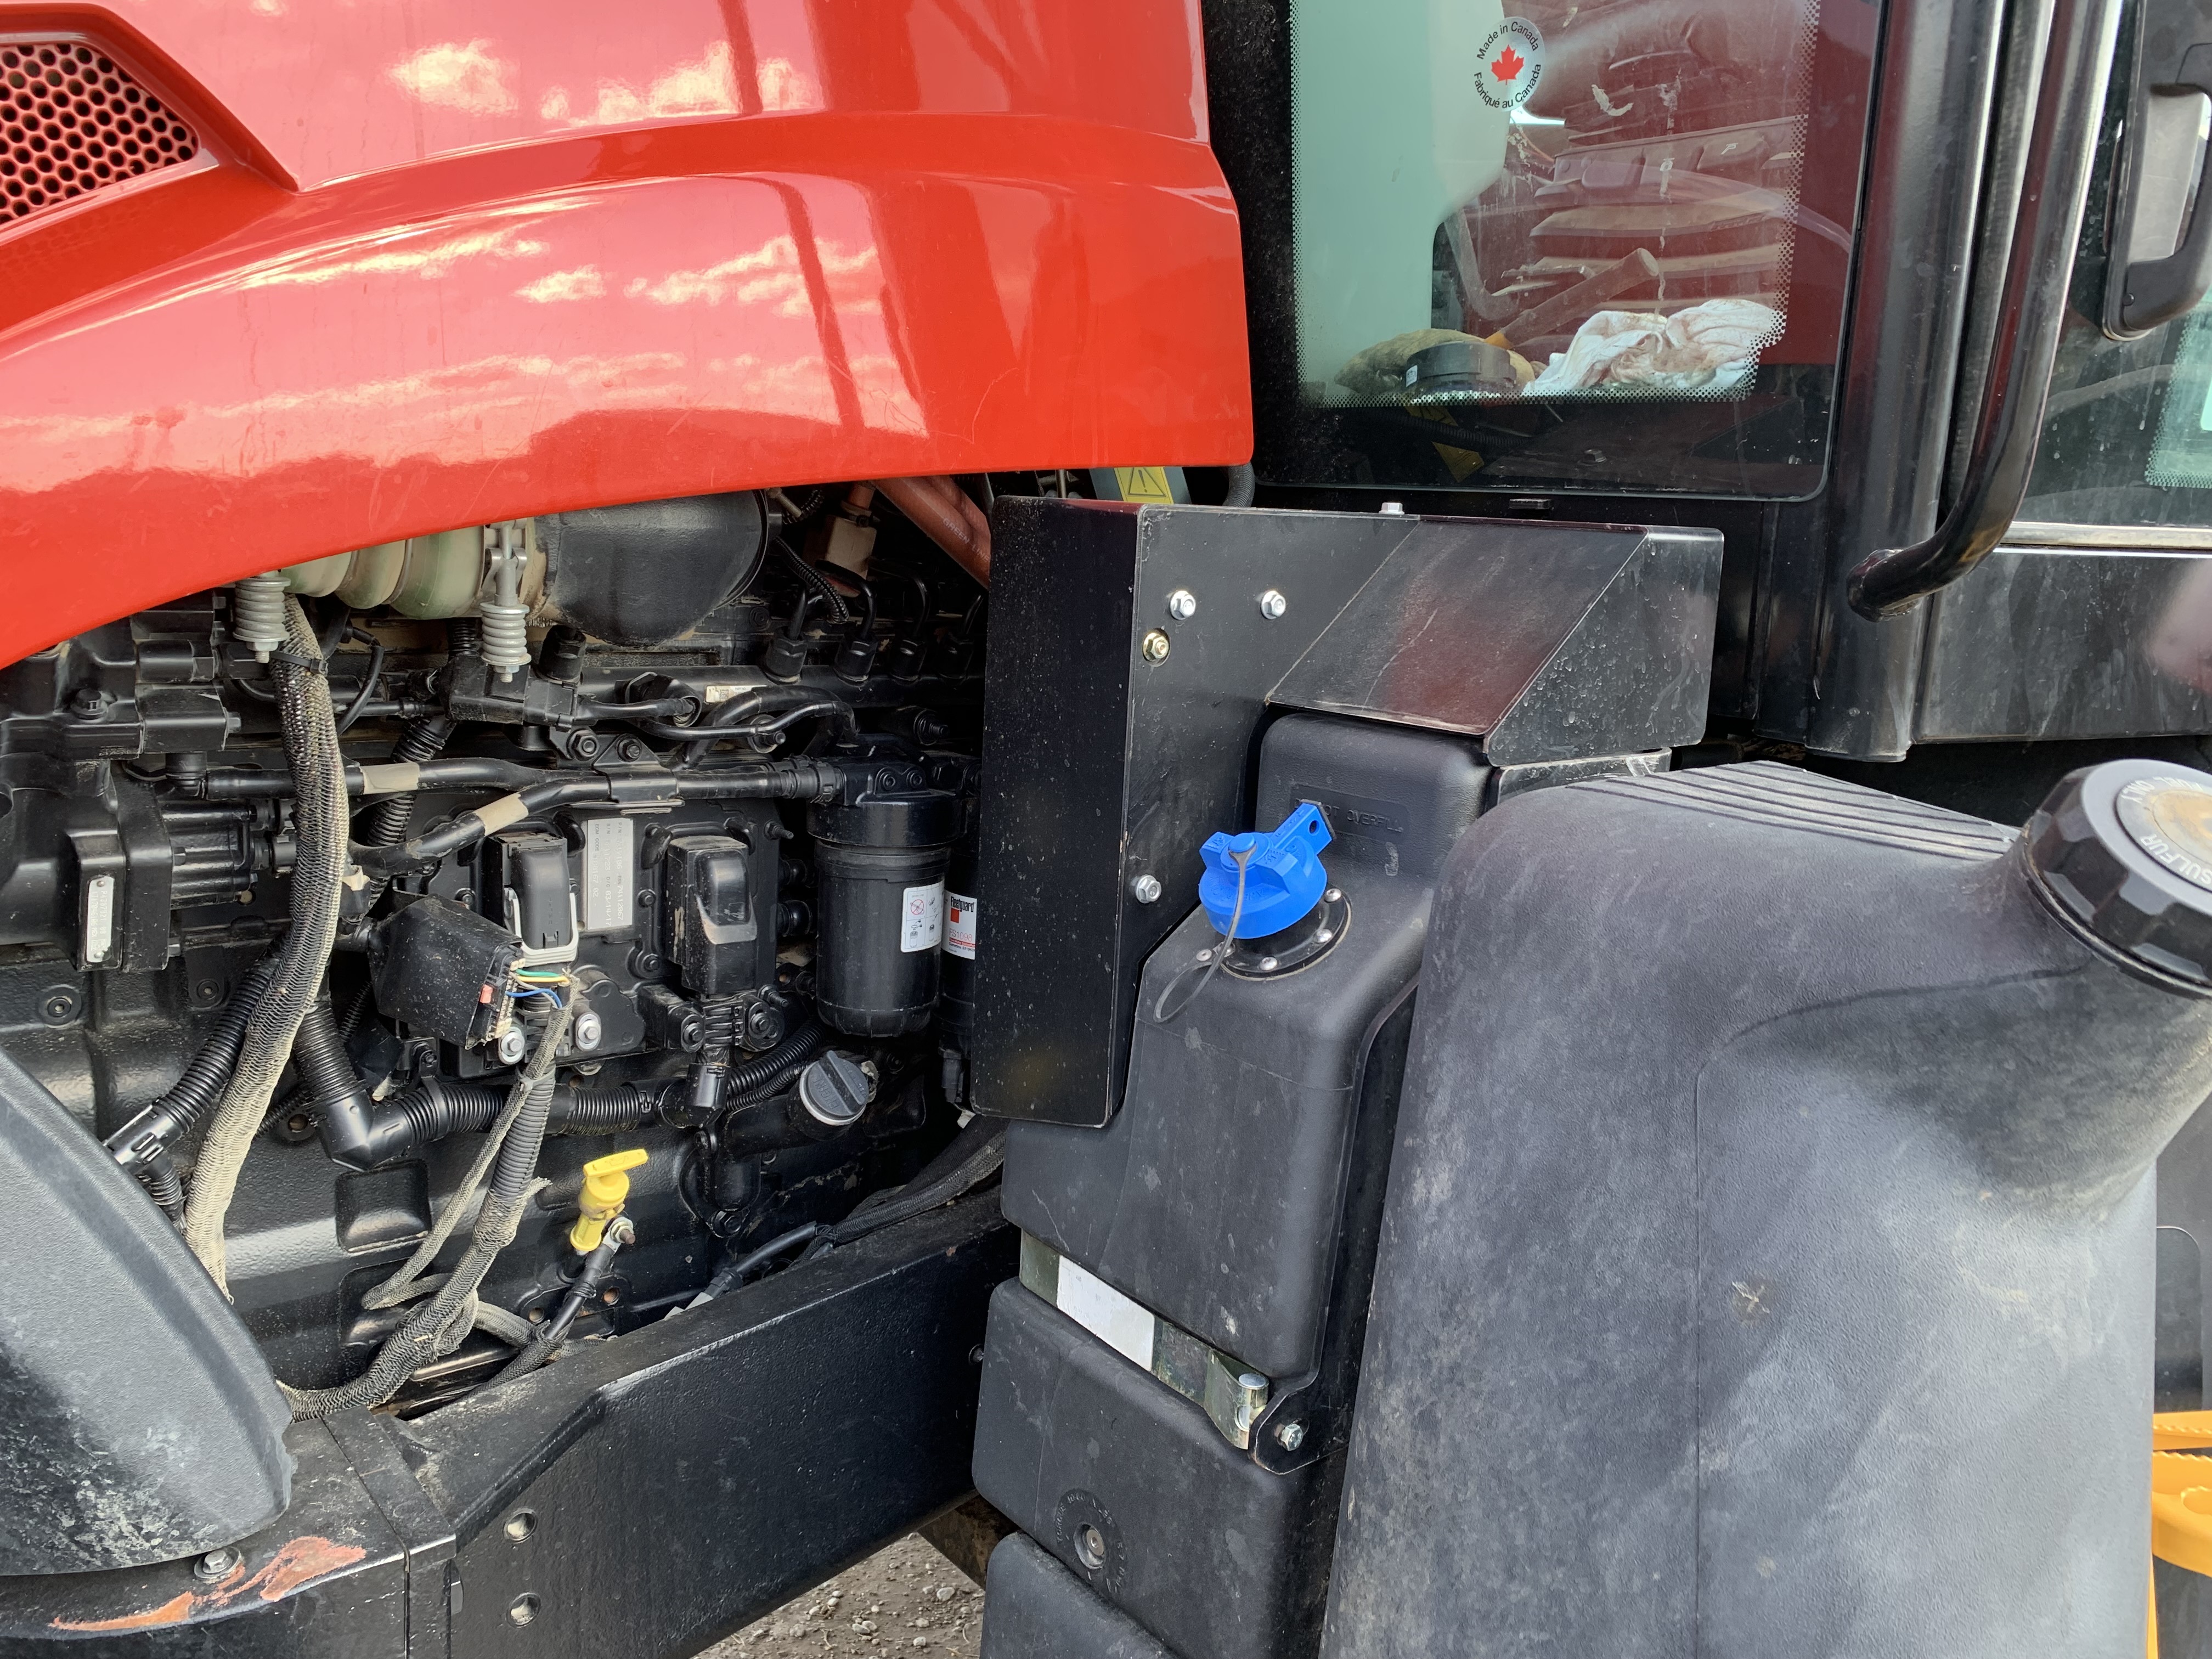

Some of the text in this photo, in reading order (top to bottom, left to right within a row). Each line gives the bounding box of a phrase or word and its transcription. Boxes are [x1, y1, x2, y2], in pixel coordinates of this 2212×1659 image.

[1477, 21, 1539, 59] Made in Canada
[1474, 64, 1541, 109] Fabriqué au Canada
[942, 516, 990, 563] GREEN LINE
[2121, 780, 2155, 804] ONLY
[1323, 804, 1340, 817] OT
[2140, 833, 2212, 885] SULFUR
[950, 896, 974, 913] Fleetguard
[949, 928, 973, 942] FS1098
[812, 1074, 840, 1110] ENGINE
